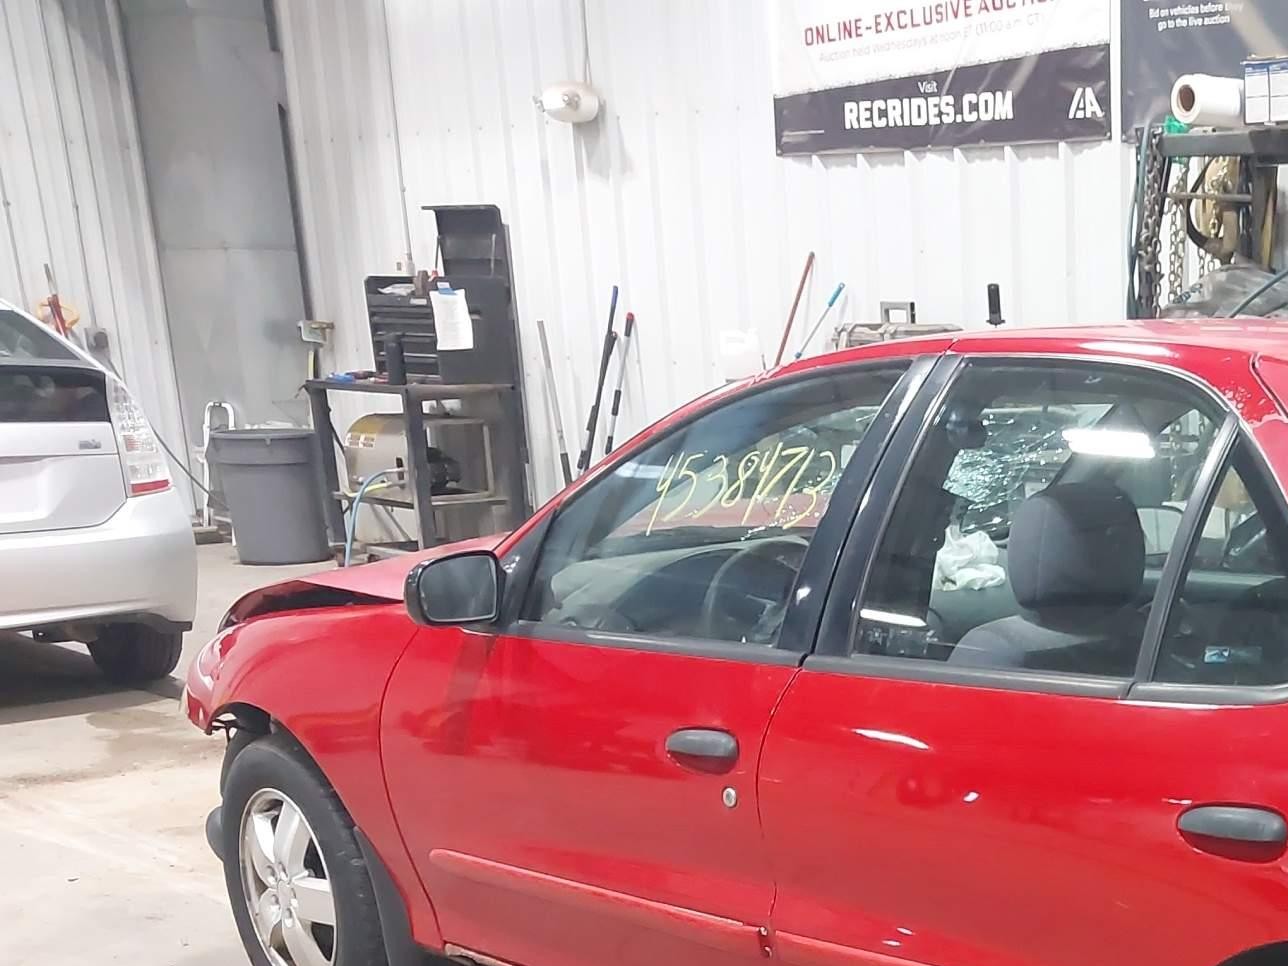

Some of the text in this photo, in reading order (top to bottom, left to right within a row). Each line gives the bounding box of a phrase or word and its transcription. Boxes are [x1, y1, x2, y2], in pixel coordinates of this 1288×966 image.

[1200, 2, 1223, 13] before
[804, 0, 973, 46] ONLINE-EXCLUSIVE
[1204, 15, 1230, 25] auction
[918, 80, 938, 94] Visit
[844, 90, 1014, 130] RECRIDES.COM
